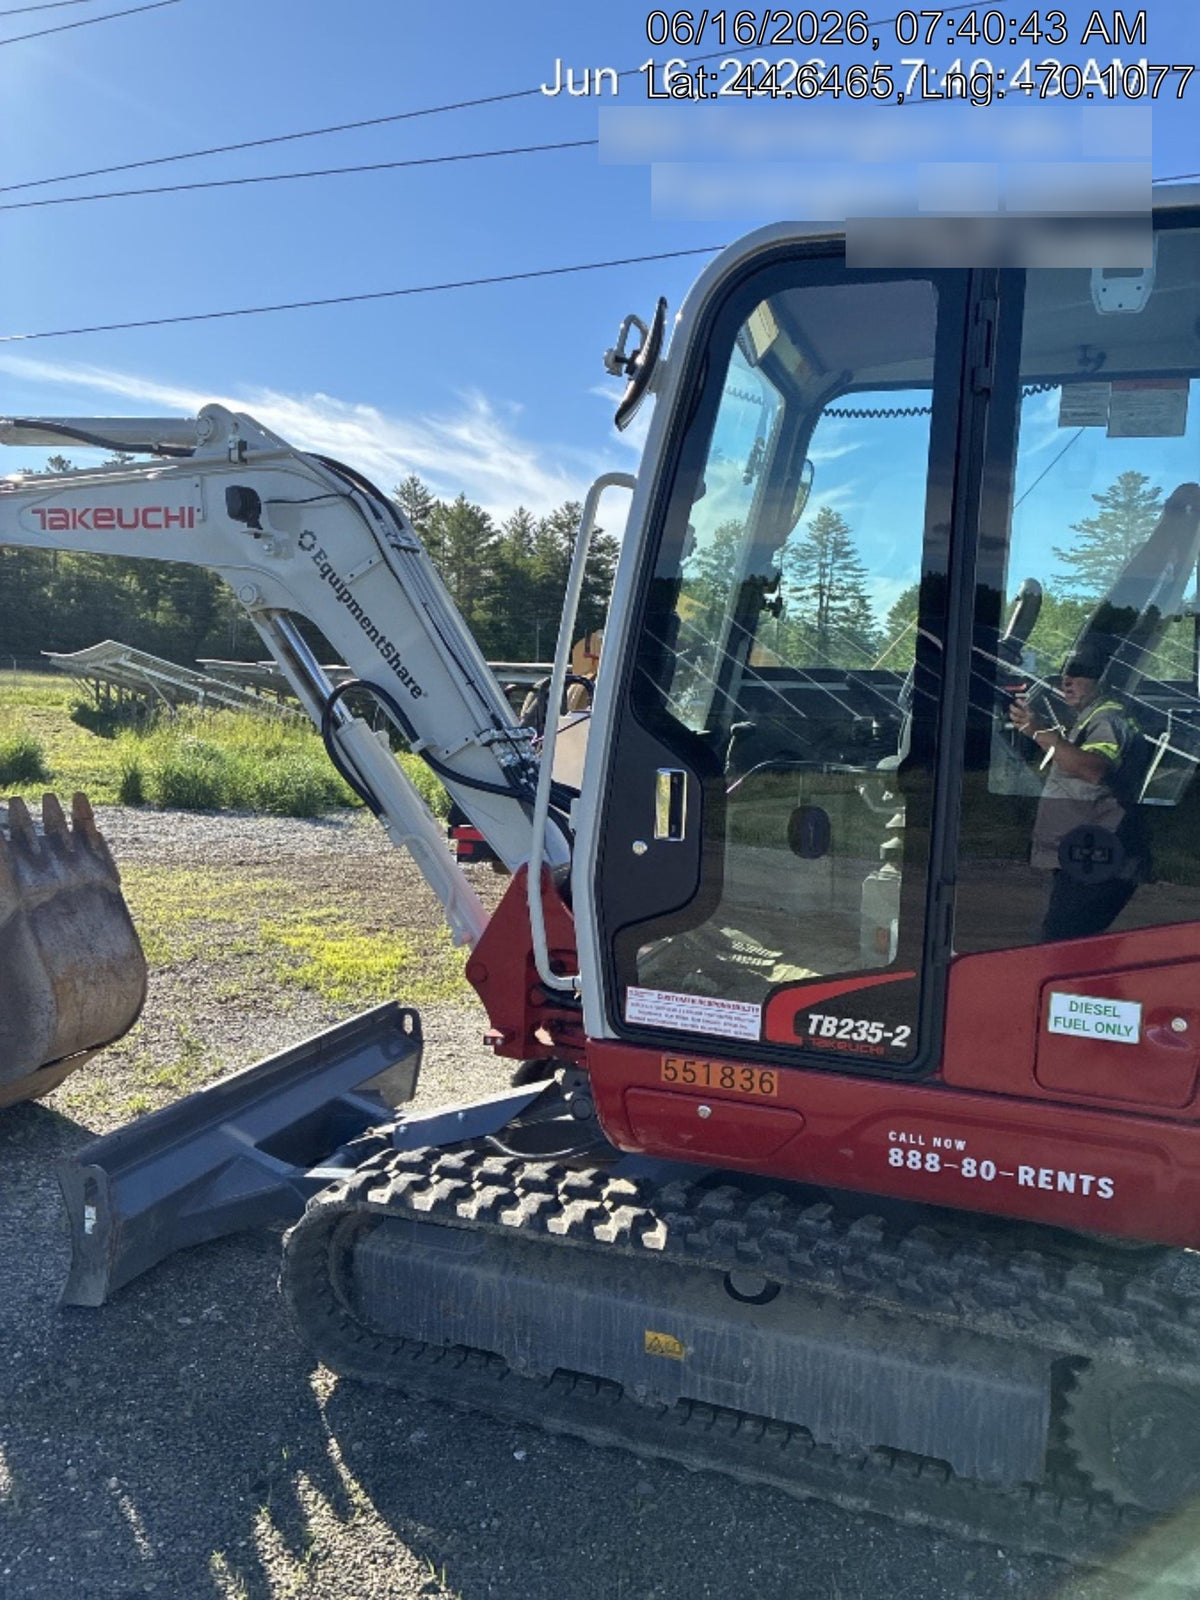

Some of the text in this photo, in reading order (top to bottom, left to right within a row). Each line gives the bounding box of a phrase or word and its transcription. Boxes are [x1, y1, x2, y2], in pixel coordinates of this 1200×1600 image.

[311, 548, 423, 699] EquipmentShare
[1053, 1016, 1134, 1037] FUEL ONLY
[1069, 1000, 1121, 1018] DIESEL
[808, 1013, 911, 1048] TB235-2
[663, 1057, 775, 1095] 551836
[888, 1131, 967, 1151] CALL NOW
[888, 1147, 1115, 1199] 888-80-RENTS
